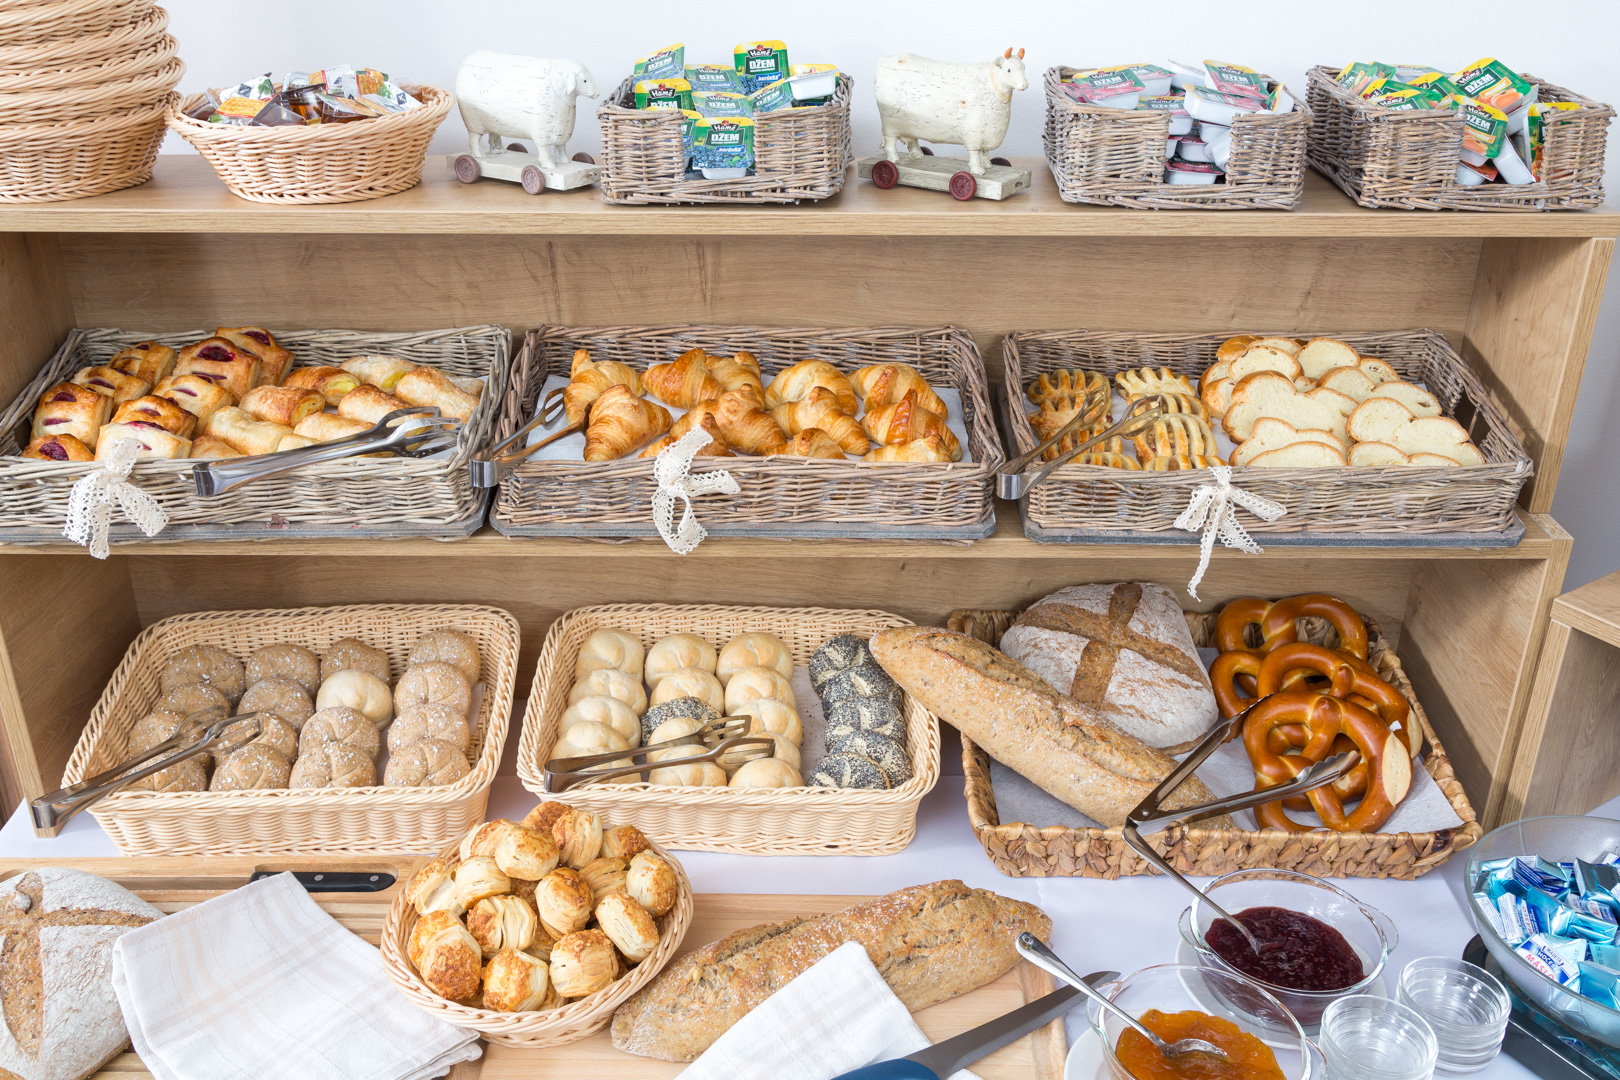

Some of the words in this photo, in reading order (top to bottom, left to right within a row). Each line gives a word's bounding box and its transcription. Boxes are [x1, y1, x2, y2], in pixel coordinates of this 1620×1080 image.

[647, 56, 673, 72] DŽEM
[748, 58, 776, 70] DŽEM
[698, 73, 726, 81] DŽEM
[1092, 76, 1123, 86] DŽEM
[1221, 72, 1249, 83] DŽEM
[1464, 73, 1495, 94] DŽEM
[650, 89, 675, 98] Hamé
[756, 90, 780, 107] DŽEM
[708, 101, 737, 110] DŽEM
[710, 132, 740, 142] DŽEM
